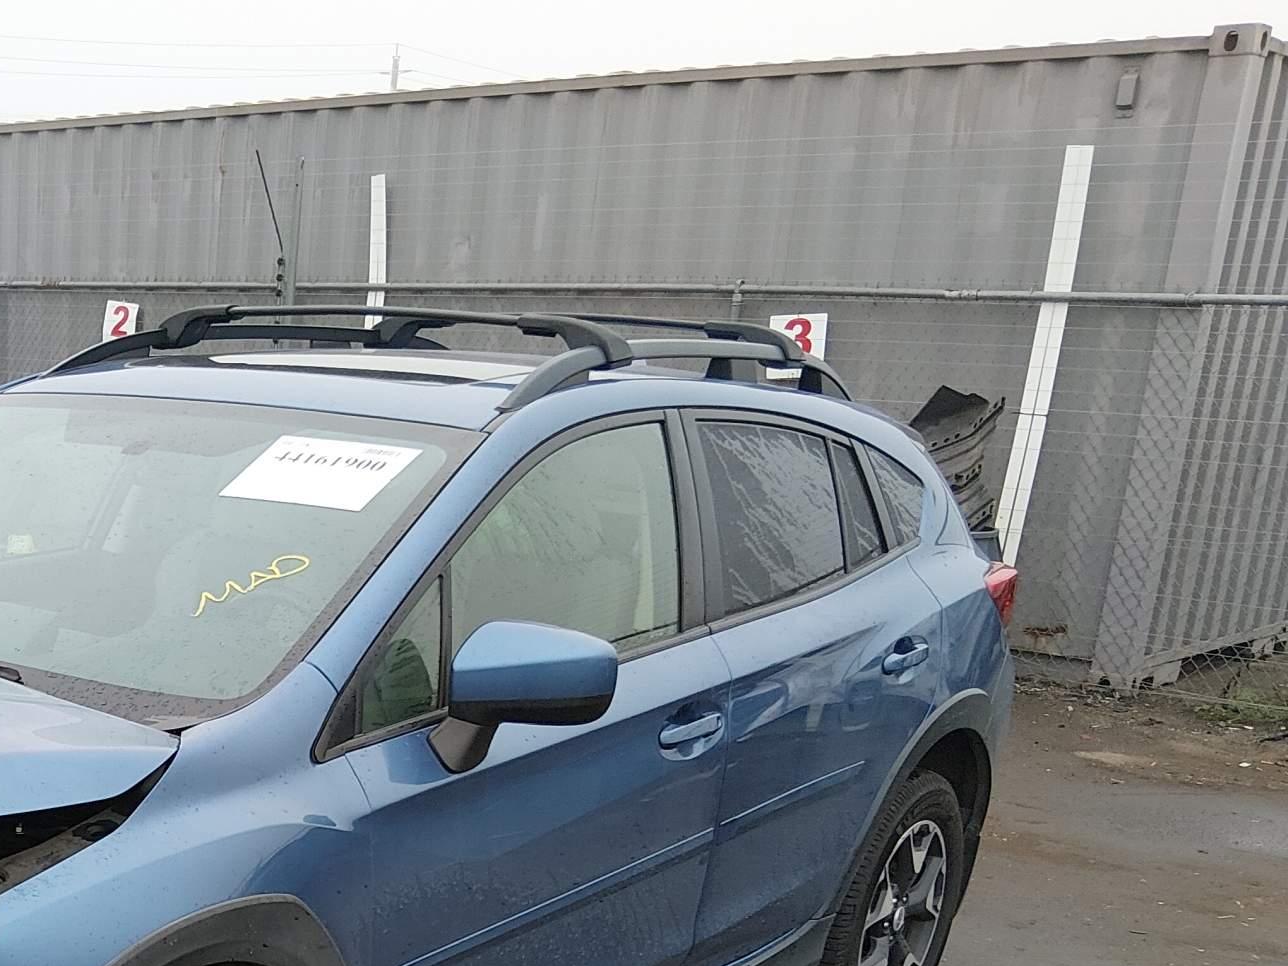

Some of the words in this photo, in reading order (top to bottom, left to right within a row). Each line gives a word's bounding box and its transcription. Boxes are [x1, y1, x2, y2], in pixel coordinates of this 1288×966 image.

[110, 305, 130, 338] 2
[784, 317, 812, 354] 3
[191, 554, 310, 617] MAD
